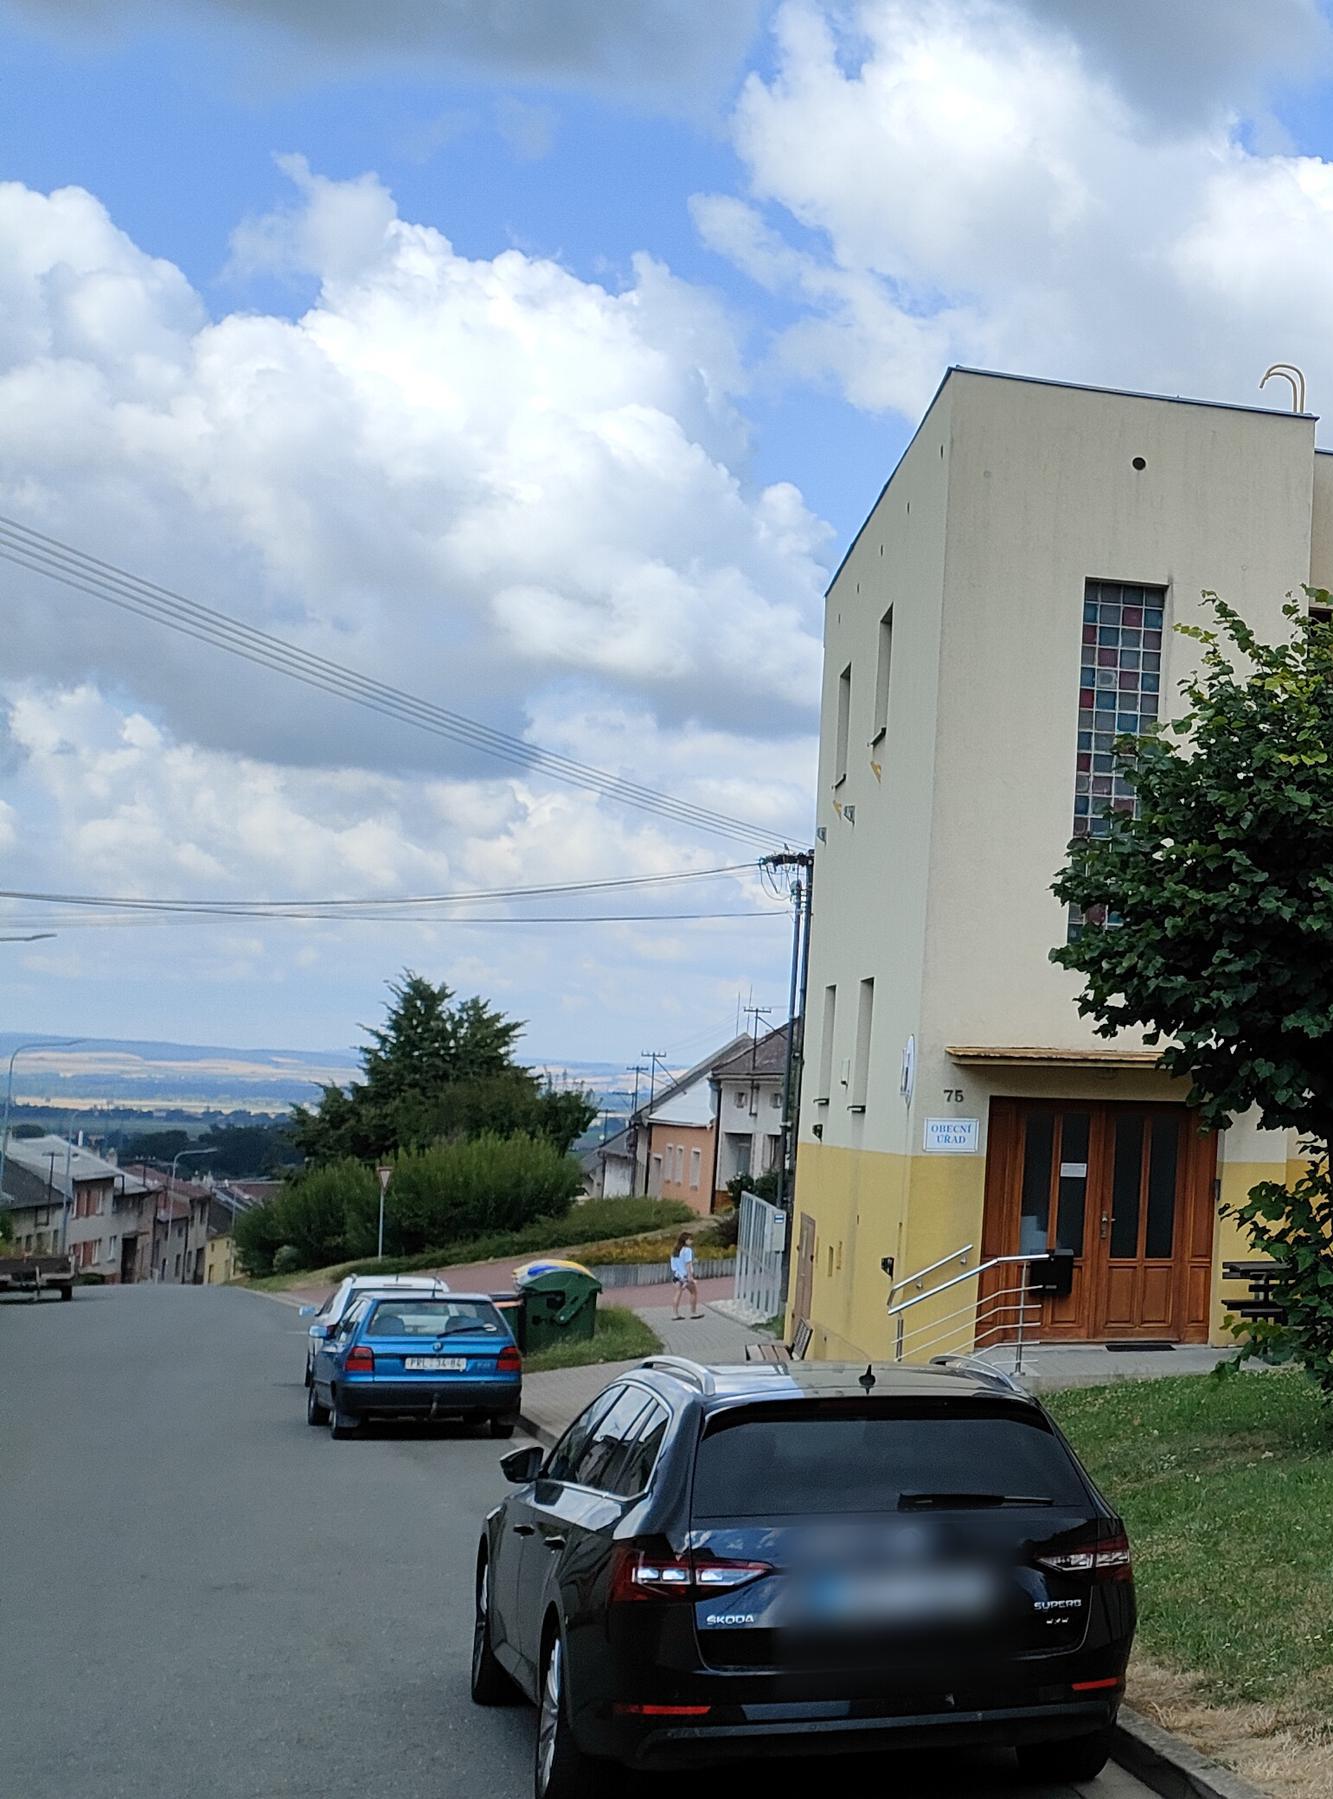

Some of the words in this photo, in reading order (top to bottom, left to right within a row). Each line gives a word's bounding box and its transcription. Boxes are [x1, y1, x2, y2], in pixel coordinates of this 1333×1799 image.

[943, 1089, 964, 1103] 75
[931, 1123, 972, 1134] OBECNÍ
[1033, 1599, 1082, 1610] SUPERB
[706, 1614, 754, 1625] ŠKODA
